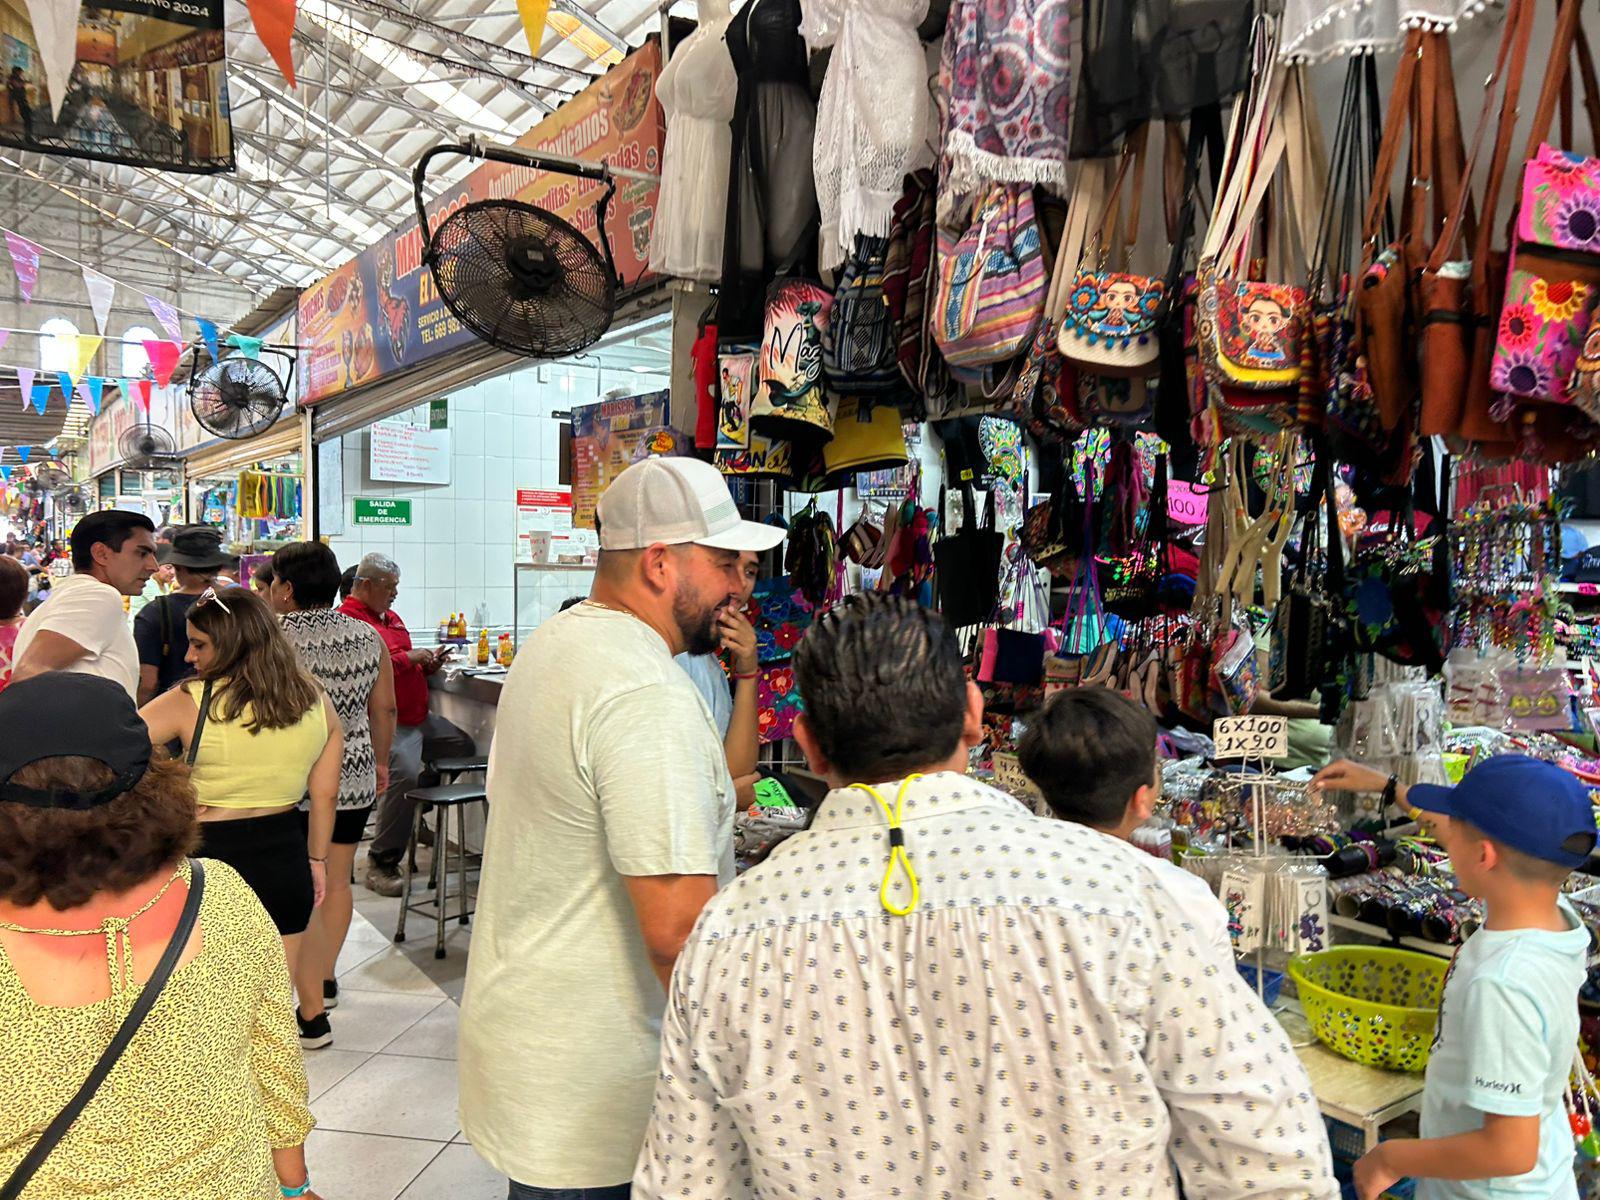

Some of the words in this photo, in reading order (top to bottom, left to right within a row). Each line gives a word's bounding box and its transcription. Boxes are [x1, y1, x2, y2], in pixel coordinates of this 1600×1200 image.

[173, 1, 209, 17] 2024
[488, 162, 537, 200] Antojitos
[421, 327, 435, 344] TEL:
[369, 500, 396, 508] SALIDA
[1475, 1076, 1509, 1092] Hurley
